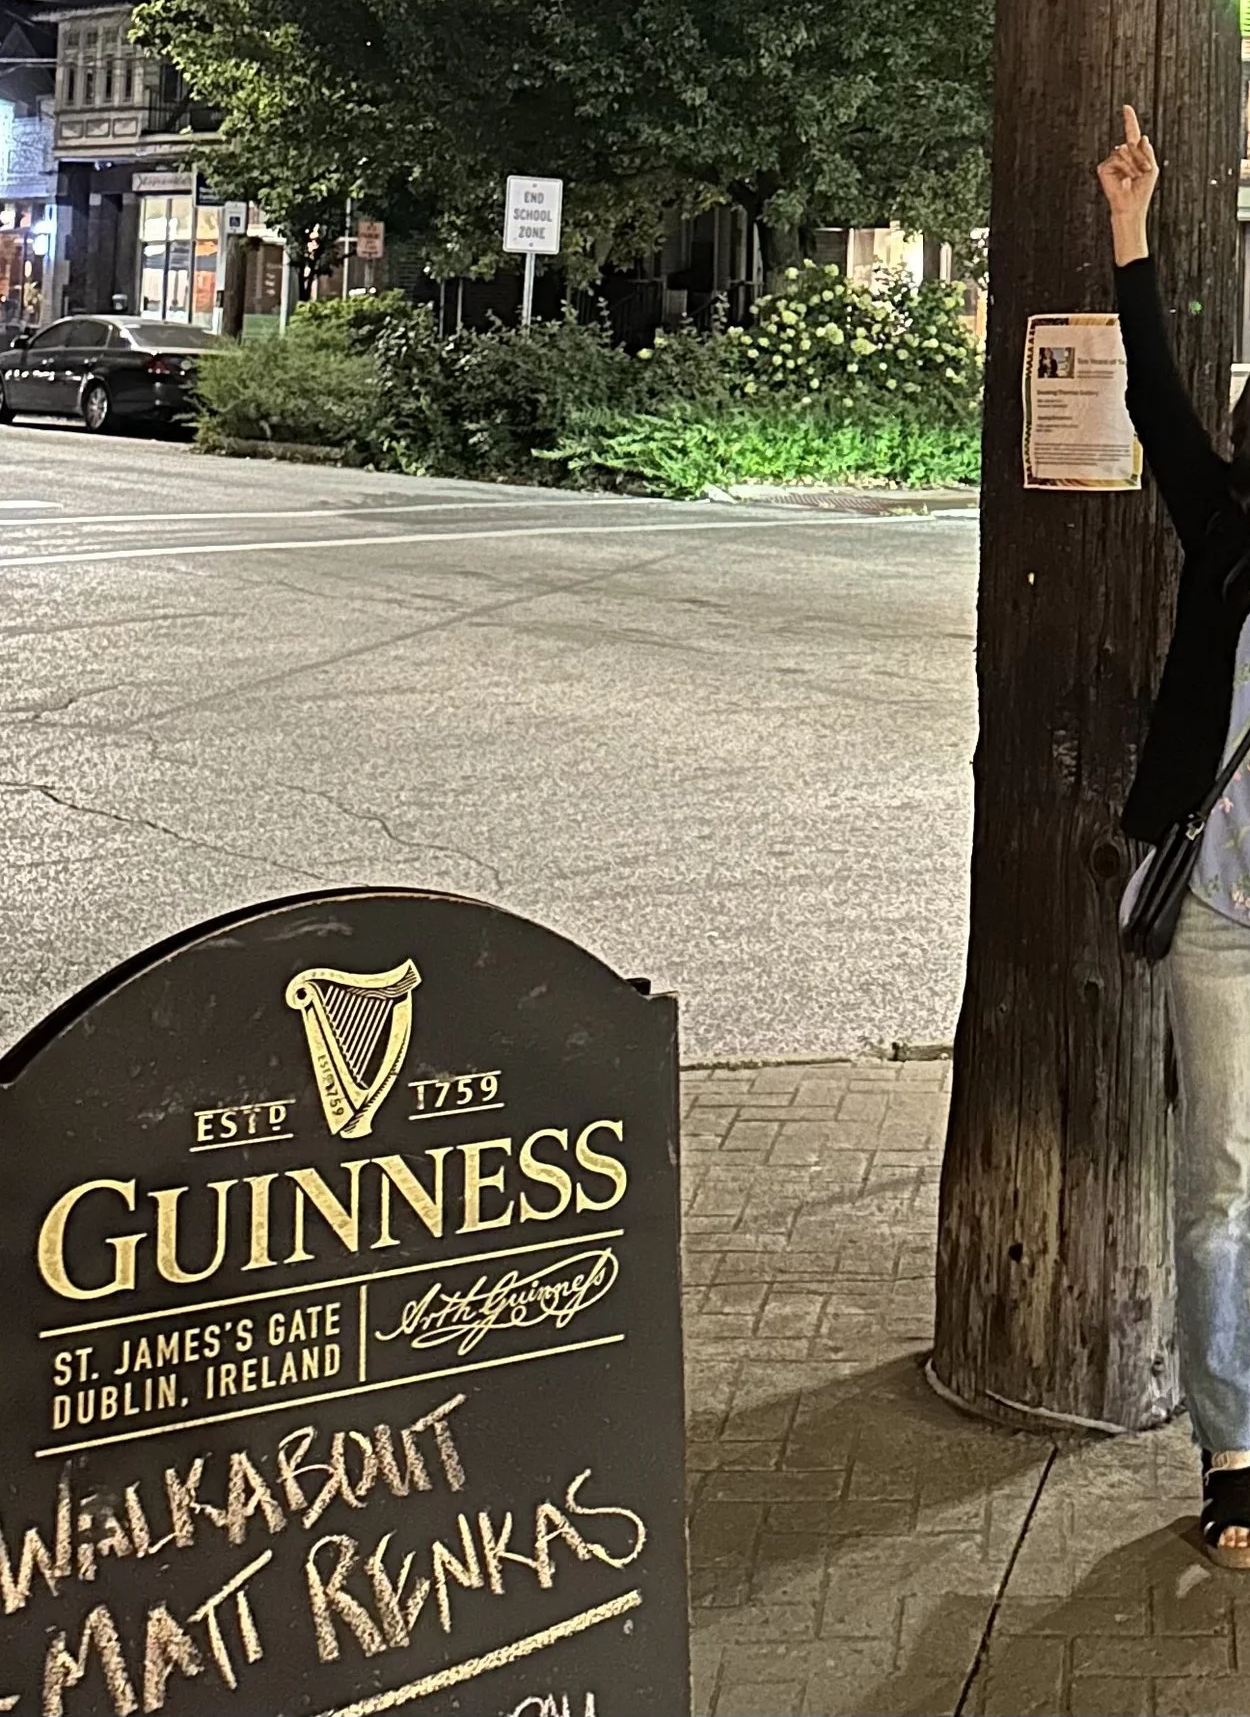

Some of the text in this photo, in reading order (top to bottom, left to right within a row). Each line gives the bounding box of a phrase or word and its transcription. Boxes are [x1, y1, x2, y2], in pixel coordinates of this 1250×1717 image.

[513, 208, 552, 222] SCHOOL
[524, 190, 544, 204] END
[518, 225, 546, 239] ZONE
[197, 1075, 499, 1142] ESTD 1759
[53, 1302, 341, 1387] ST. JAMES'S GATE
[52, 1343, 341, 1431] DUBLIN, IRELAND
[306, 1468, 648, 1663] RENKAS
